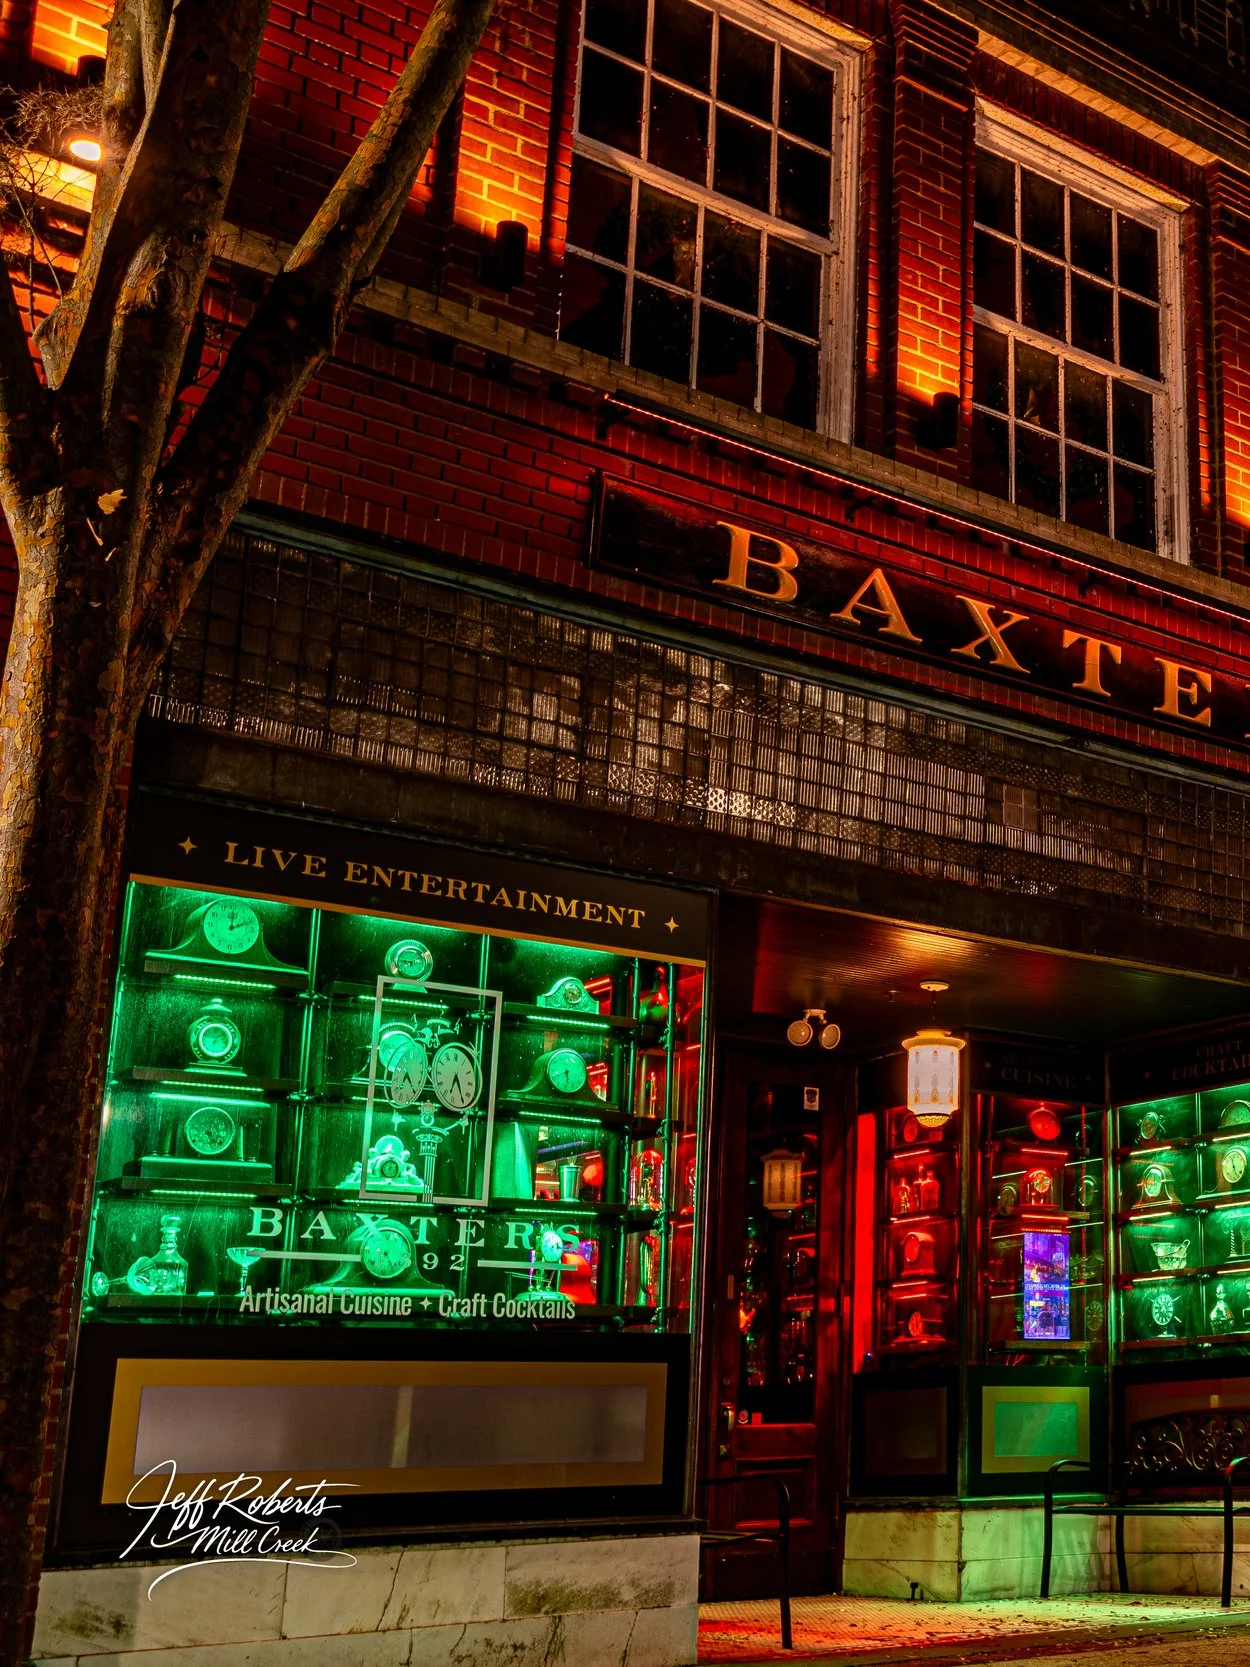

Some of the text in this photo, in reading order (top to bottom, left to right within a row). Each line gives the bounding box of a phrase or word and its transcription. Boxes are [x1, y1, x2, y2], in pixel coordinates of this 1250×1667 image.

[224, 841, 646, 929] LIVE ENTERTAINMENT
[1196, 1039, 1243, 1058] CRAFT
[1000, 1066, 1077, 1089] CUISINE
[247, 1206, 580, 1253] BAXTERS
[239, 1285, 576, 1320] Artisanal Cuisine Craft Cocktails
